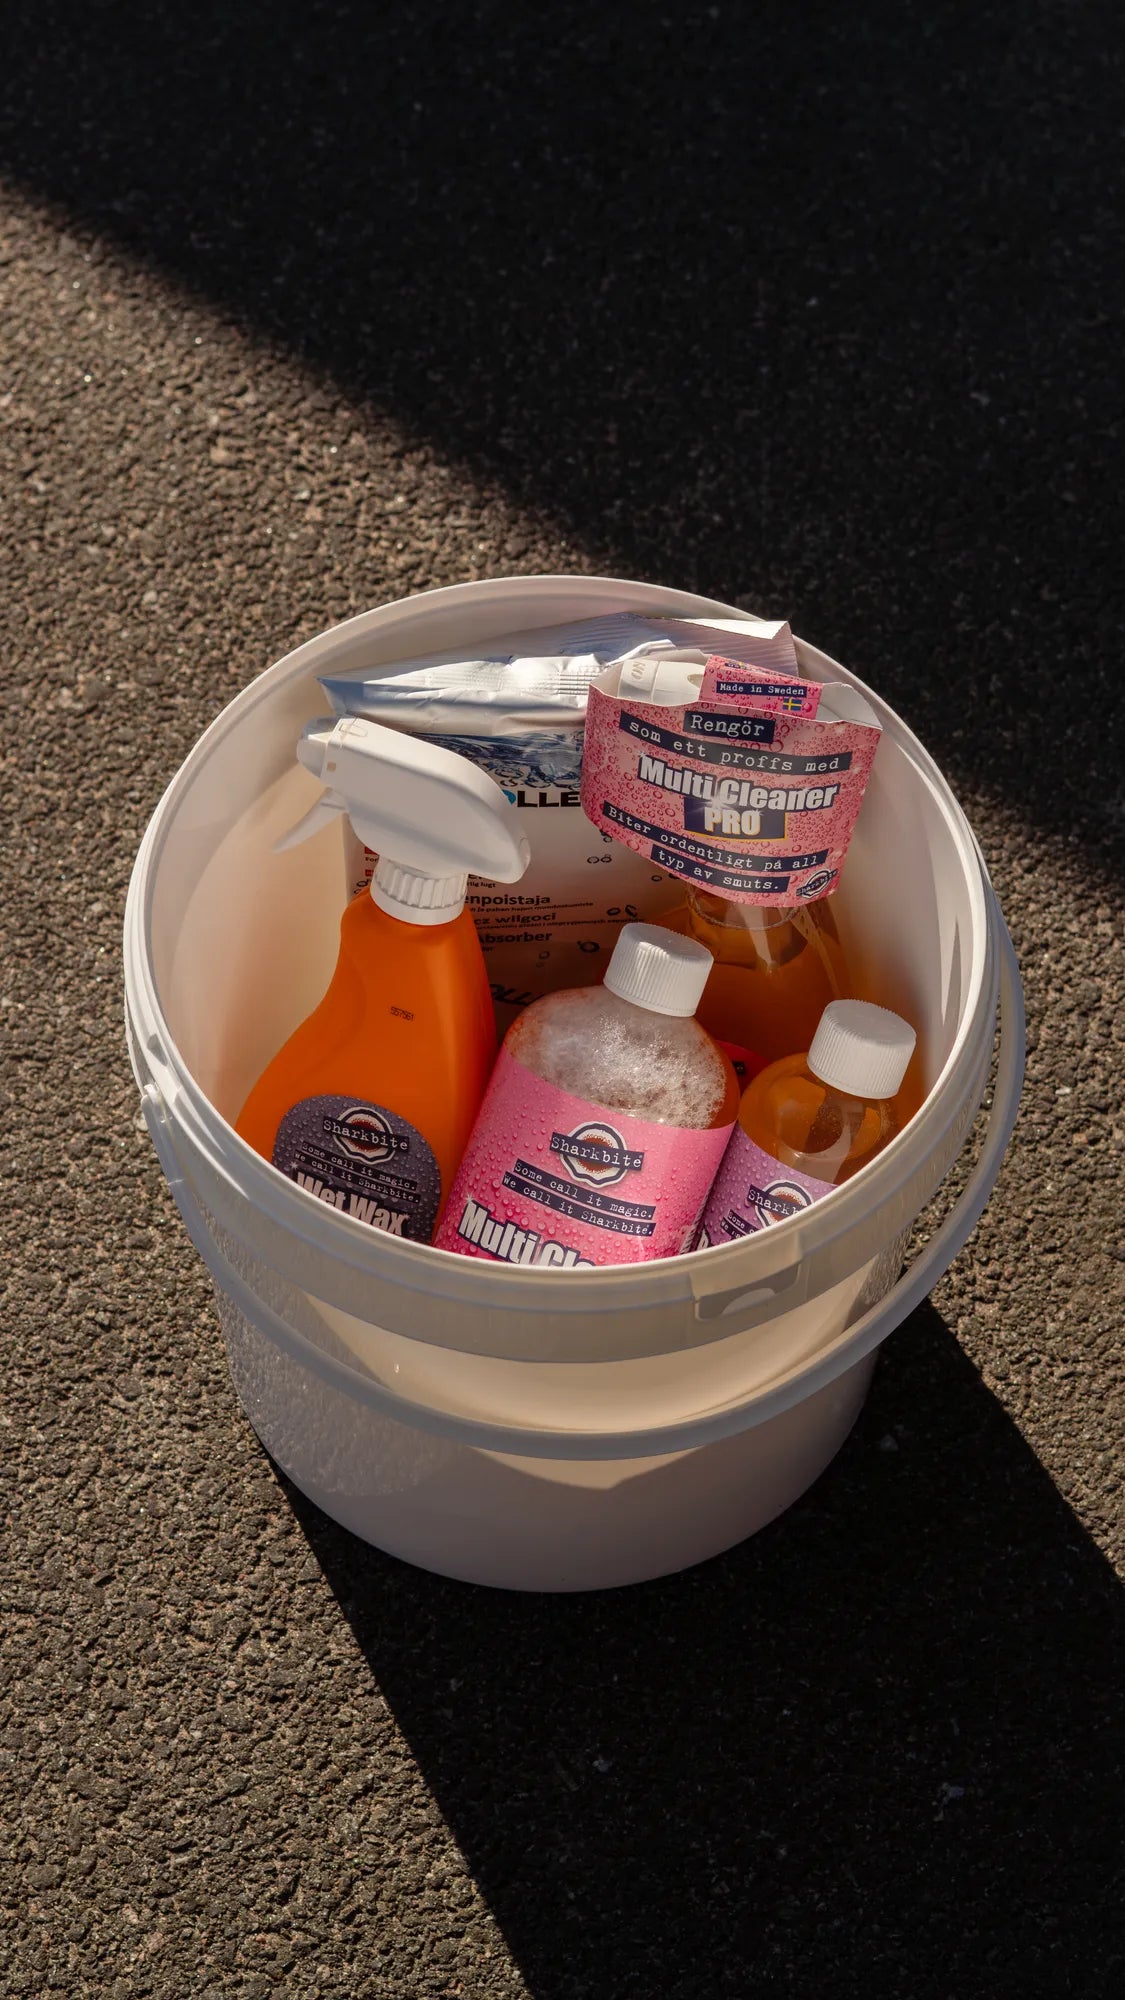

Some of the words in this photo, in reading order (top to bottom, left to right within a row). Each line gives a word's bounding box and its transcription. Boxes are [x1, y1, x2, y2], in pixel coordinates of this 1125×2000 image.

[719, 683, 744, 692] Made
[750, 685, 762, 693] in
[767, 686, 804, 695] Sweden
[629, 722, 662, 744] som
[673, 738, 707, 758] ett
[720, 750, 793, 772] proffs
[804, 757, 839, 773] med
[690, 715, 765, 738] Rengör
[639, 755, 716, 801] Multi
[716, 778, 840, 812] Cleaner
[607, 806, 652, 835] Biter
[659, 832, 754, 869] ordentligt
[764, 857, 784, 872] på
[791, 855, 818, 869] all
[704, 807, 762, 836] PRO
[658, 849, 685, 872] typ
[693, 864, 713, 880] av
[722, 874, 780, 891] smuts.
[494, 912, 557, 924] wilgoci
[323, 1119, 409, 1151] Sharkbite
[551, 1136, 642, 1169] Sharkbite
[302, 1142, 326, 1159] Some
[331, 1155, 355, 1170] call
[361, 1166, 373, 1177] it
[379, 1173, 416, 1190] magic.
[311, 1159, 335, 1174] call
[340, 1170, 353, 1182] it
[358, 1178, 420, 1203] Sharkbite.
[297, 1171, 347, 1209] Wet
[350, 1193, 407, 1236] Wax
[502, 1174, 517, 1189] We
[523, 1186, 551, 1204] call
[558, 1201, 574, 1215] it
[514, 1162, 543, 1183] Some
[550, 1180, 578, 1199] call
[586, 1195, 603, 1207] it
[610, 1203, 653, 1219] magic.
[457, 1200, 540, 1265] Multi
[538, 1241, 597, 1267] Cl
[728, 1211, 745, 1229] Some
